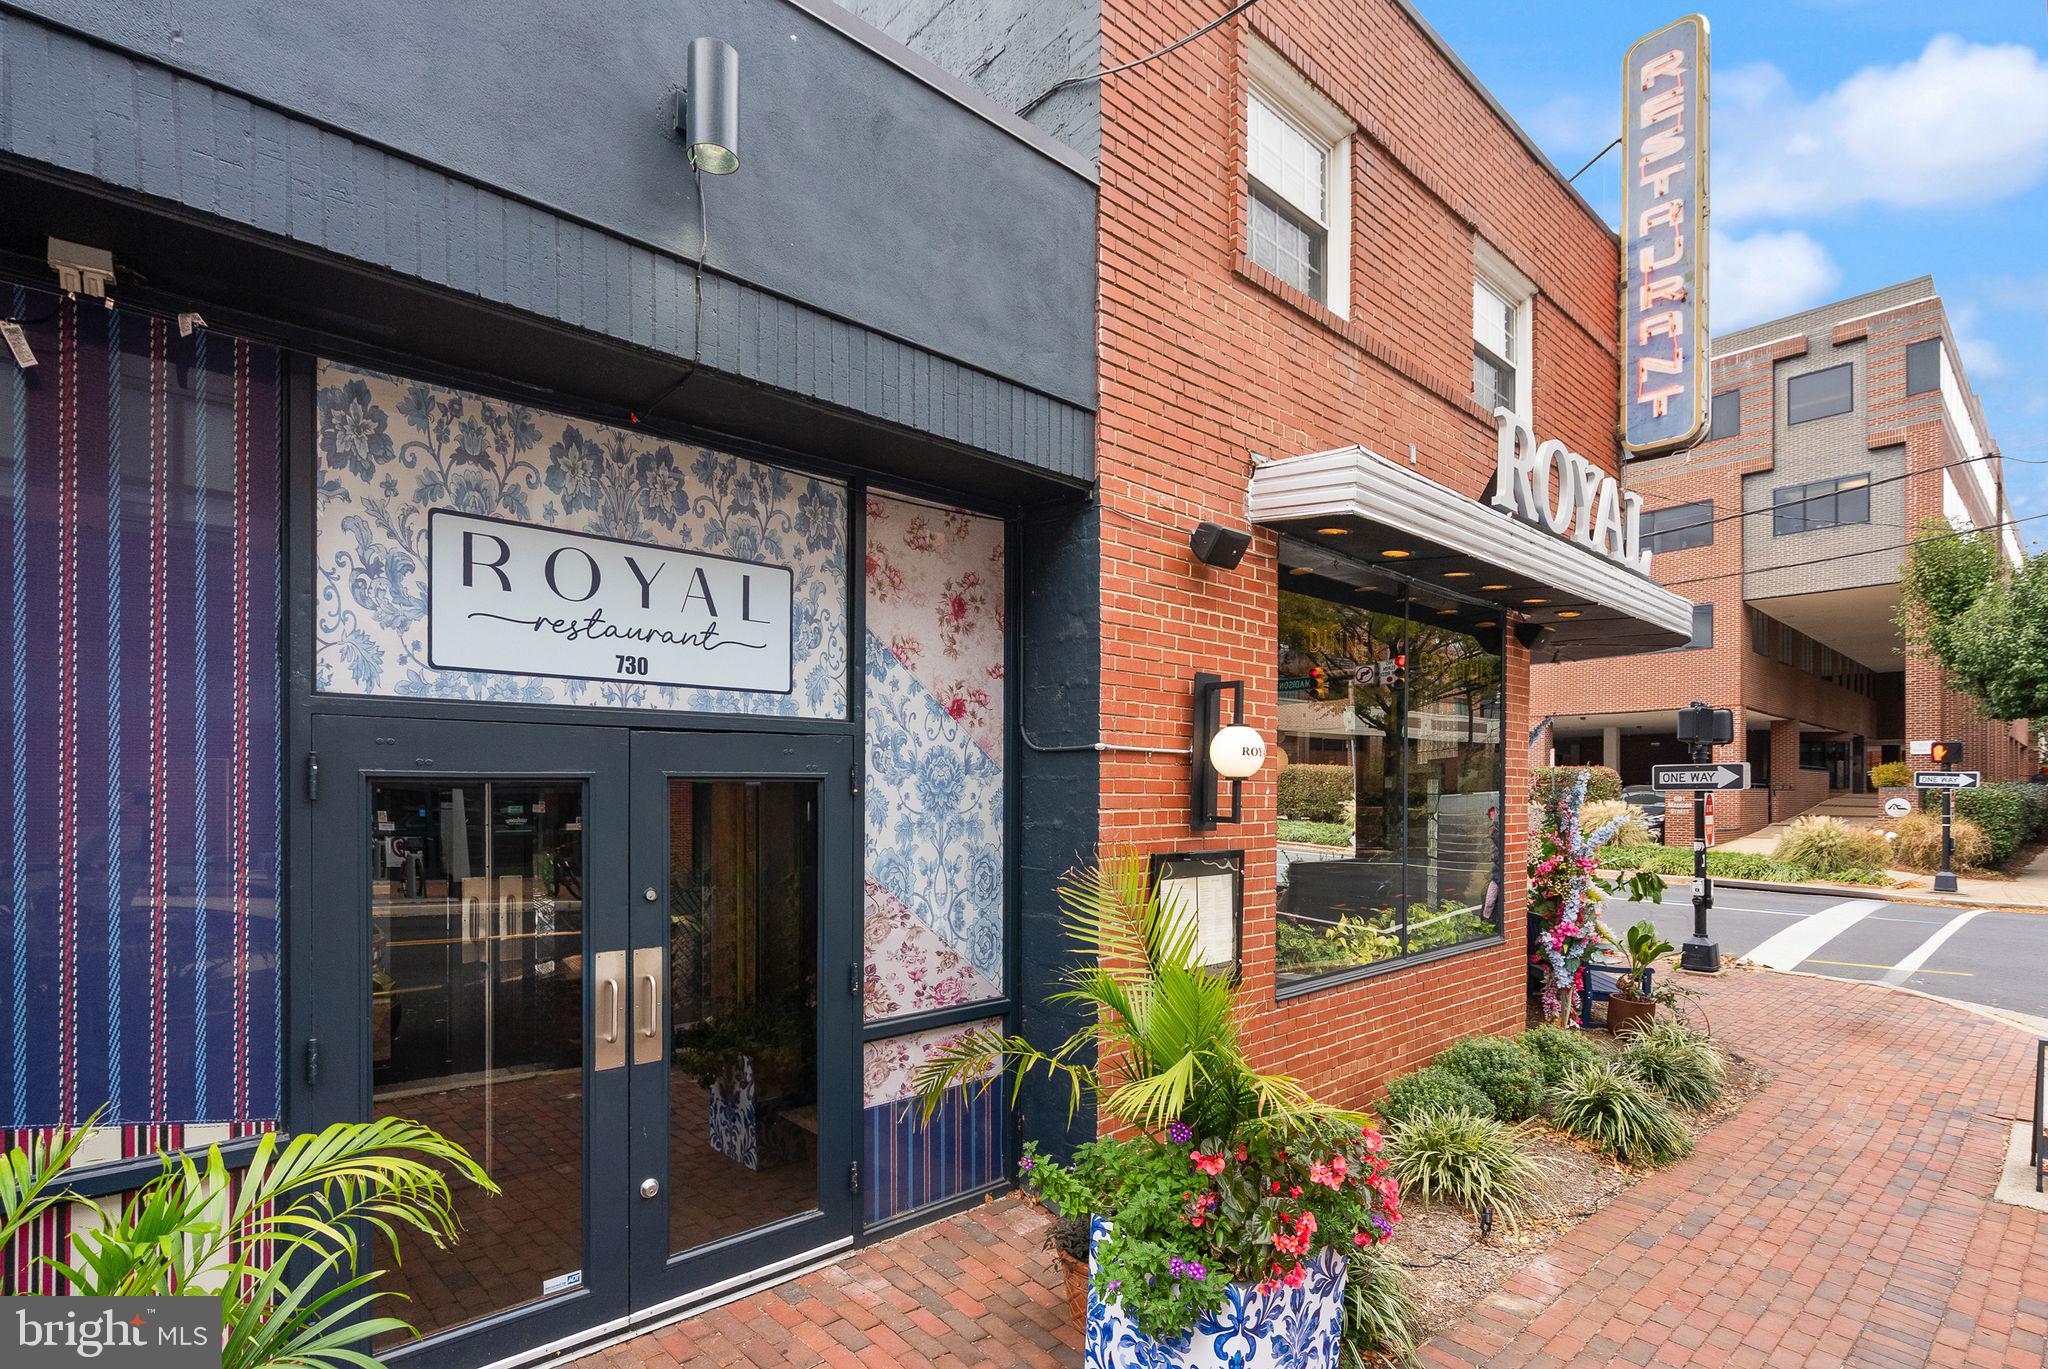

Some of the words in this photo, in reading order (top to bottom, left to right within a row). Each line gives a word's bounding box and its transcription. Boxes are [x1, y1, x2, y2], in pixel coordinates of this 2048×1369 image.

[1638, 48, 1687, 418] RESTAURANT
[1491, 406, 1653, 577] ROYAL
[462, 531, 770, 624] ROYAL
[467, 607, 767, 651] restaurant
[615, 654, 648, 676] 730
[1662, 772, 1686, 783] ONE
[1690, 772, 1715, 783] WAY
